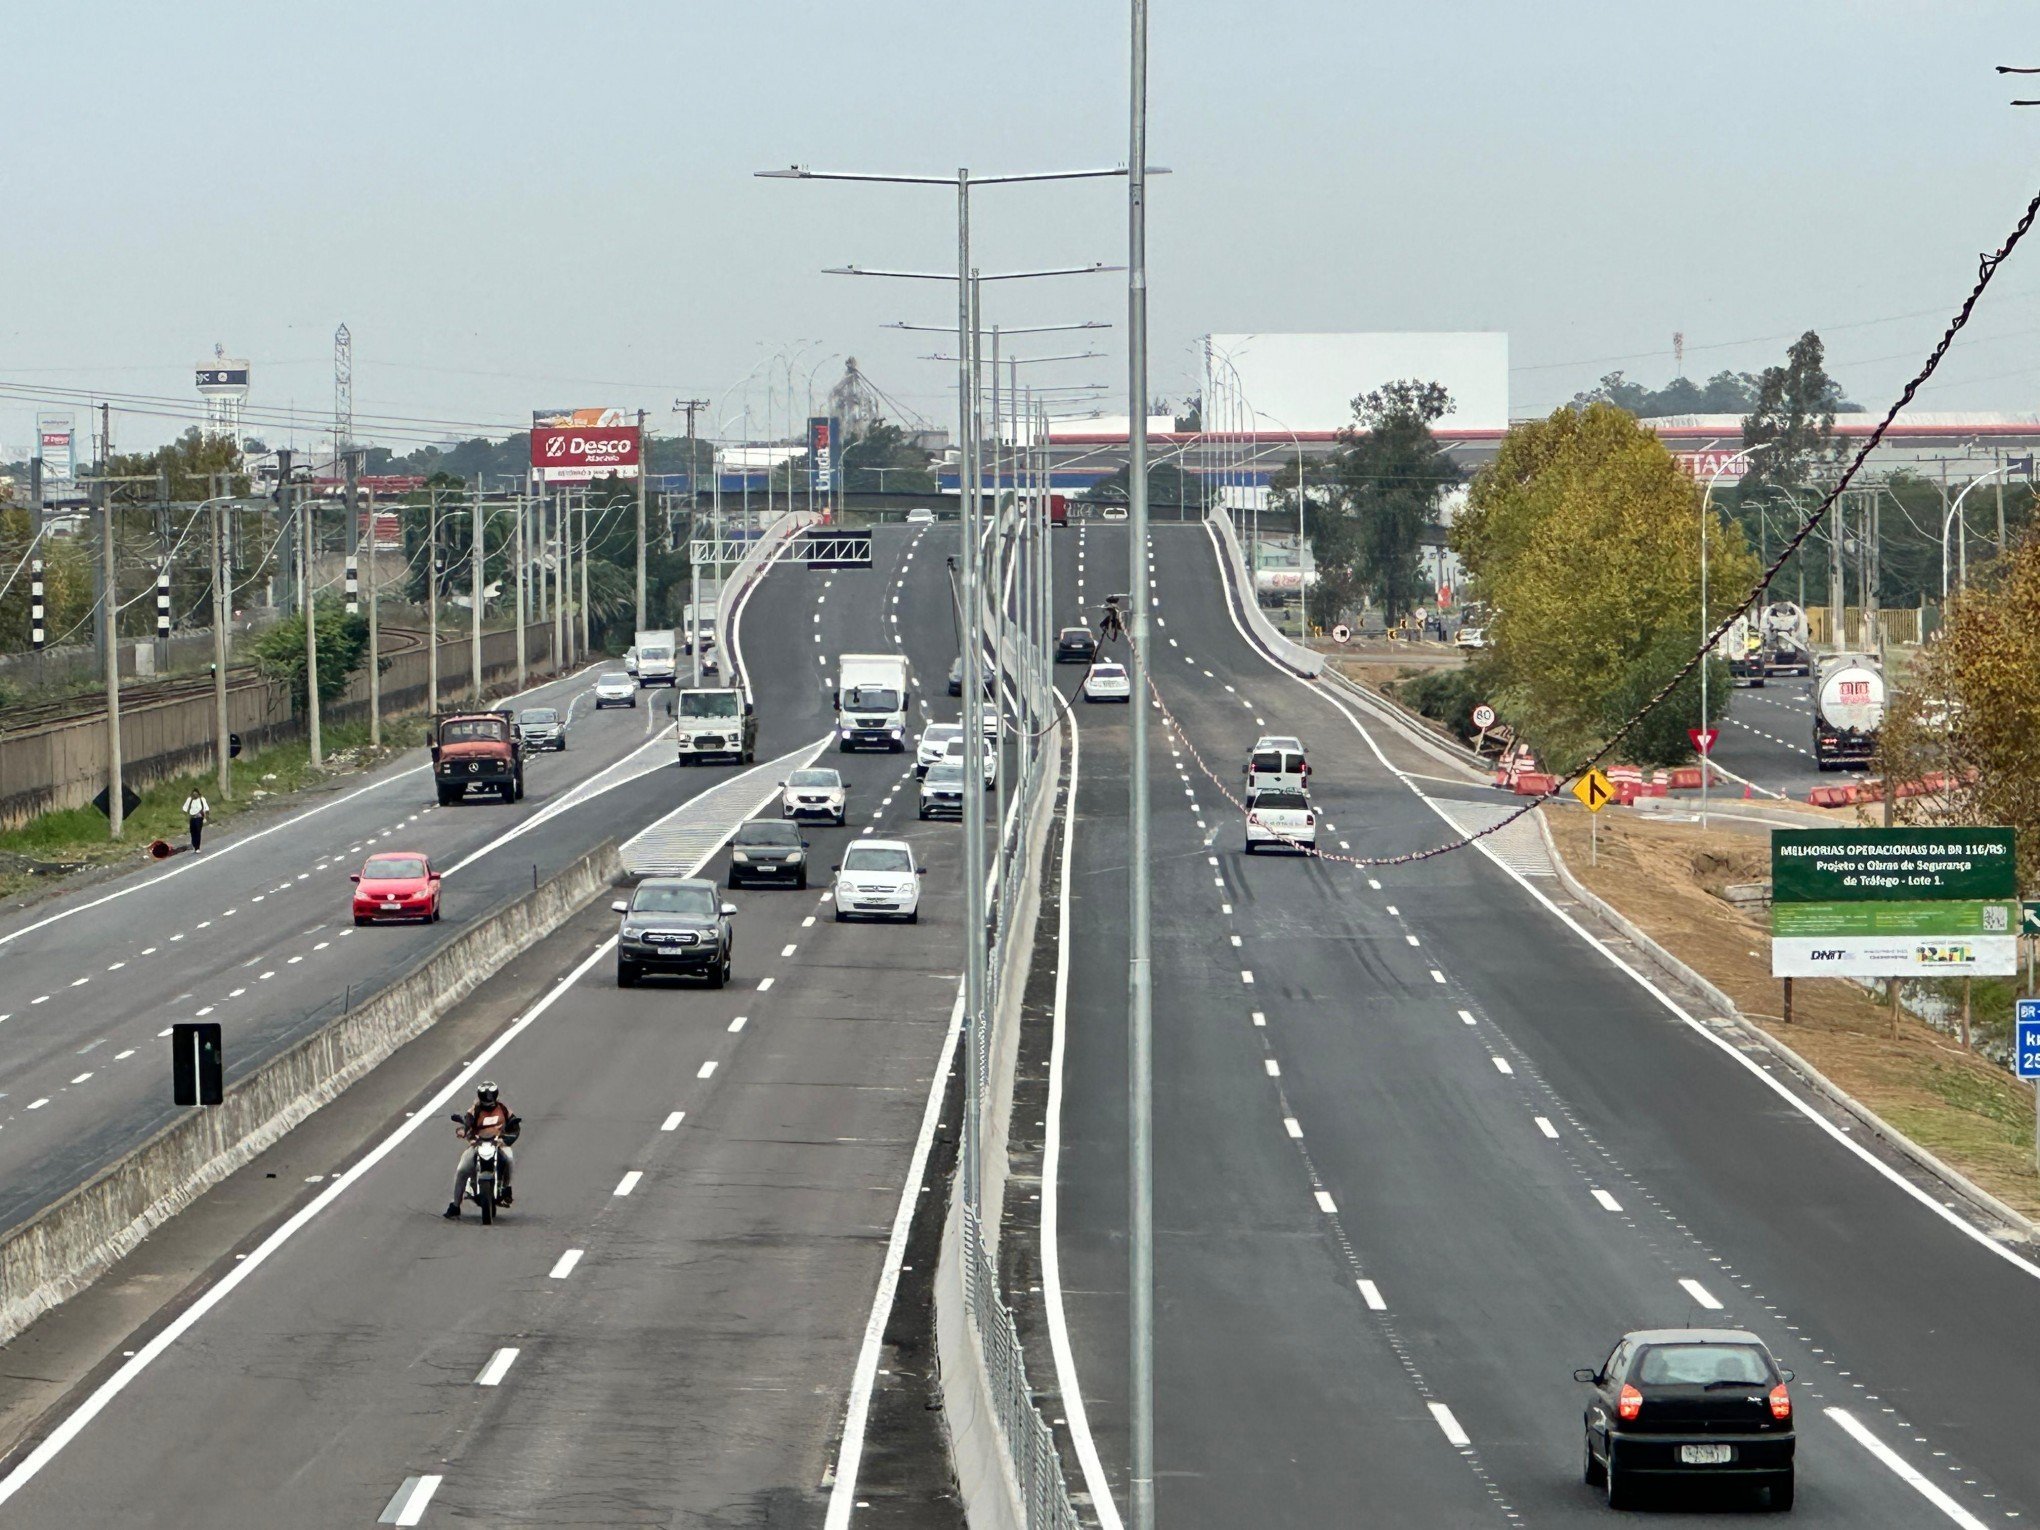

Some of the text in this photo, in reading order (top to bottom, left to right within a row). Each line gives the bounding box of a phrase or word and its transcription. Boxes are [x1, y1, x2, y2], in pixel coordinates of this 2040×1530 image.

[569, 437, 632, 455] Desco
[1476, 709, 1491, 720] 80
[1780, 845, 1845, 856] MELHORIAS
[1846, 844, 1928, 856] OPERACIONAIS
[1929, 844, 1946, 855] DA
[1947, 844, 1963, 855] BR
[1816, 860, 1972, 873] Projeto e Obras de Segurança
[1843, 875, 1858, 886] de
[1859, 875, 1900, 888] Tráfego
[1908, 875, 1932, 886] Lote
[1810, 950, 1846, 961] DNIT
